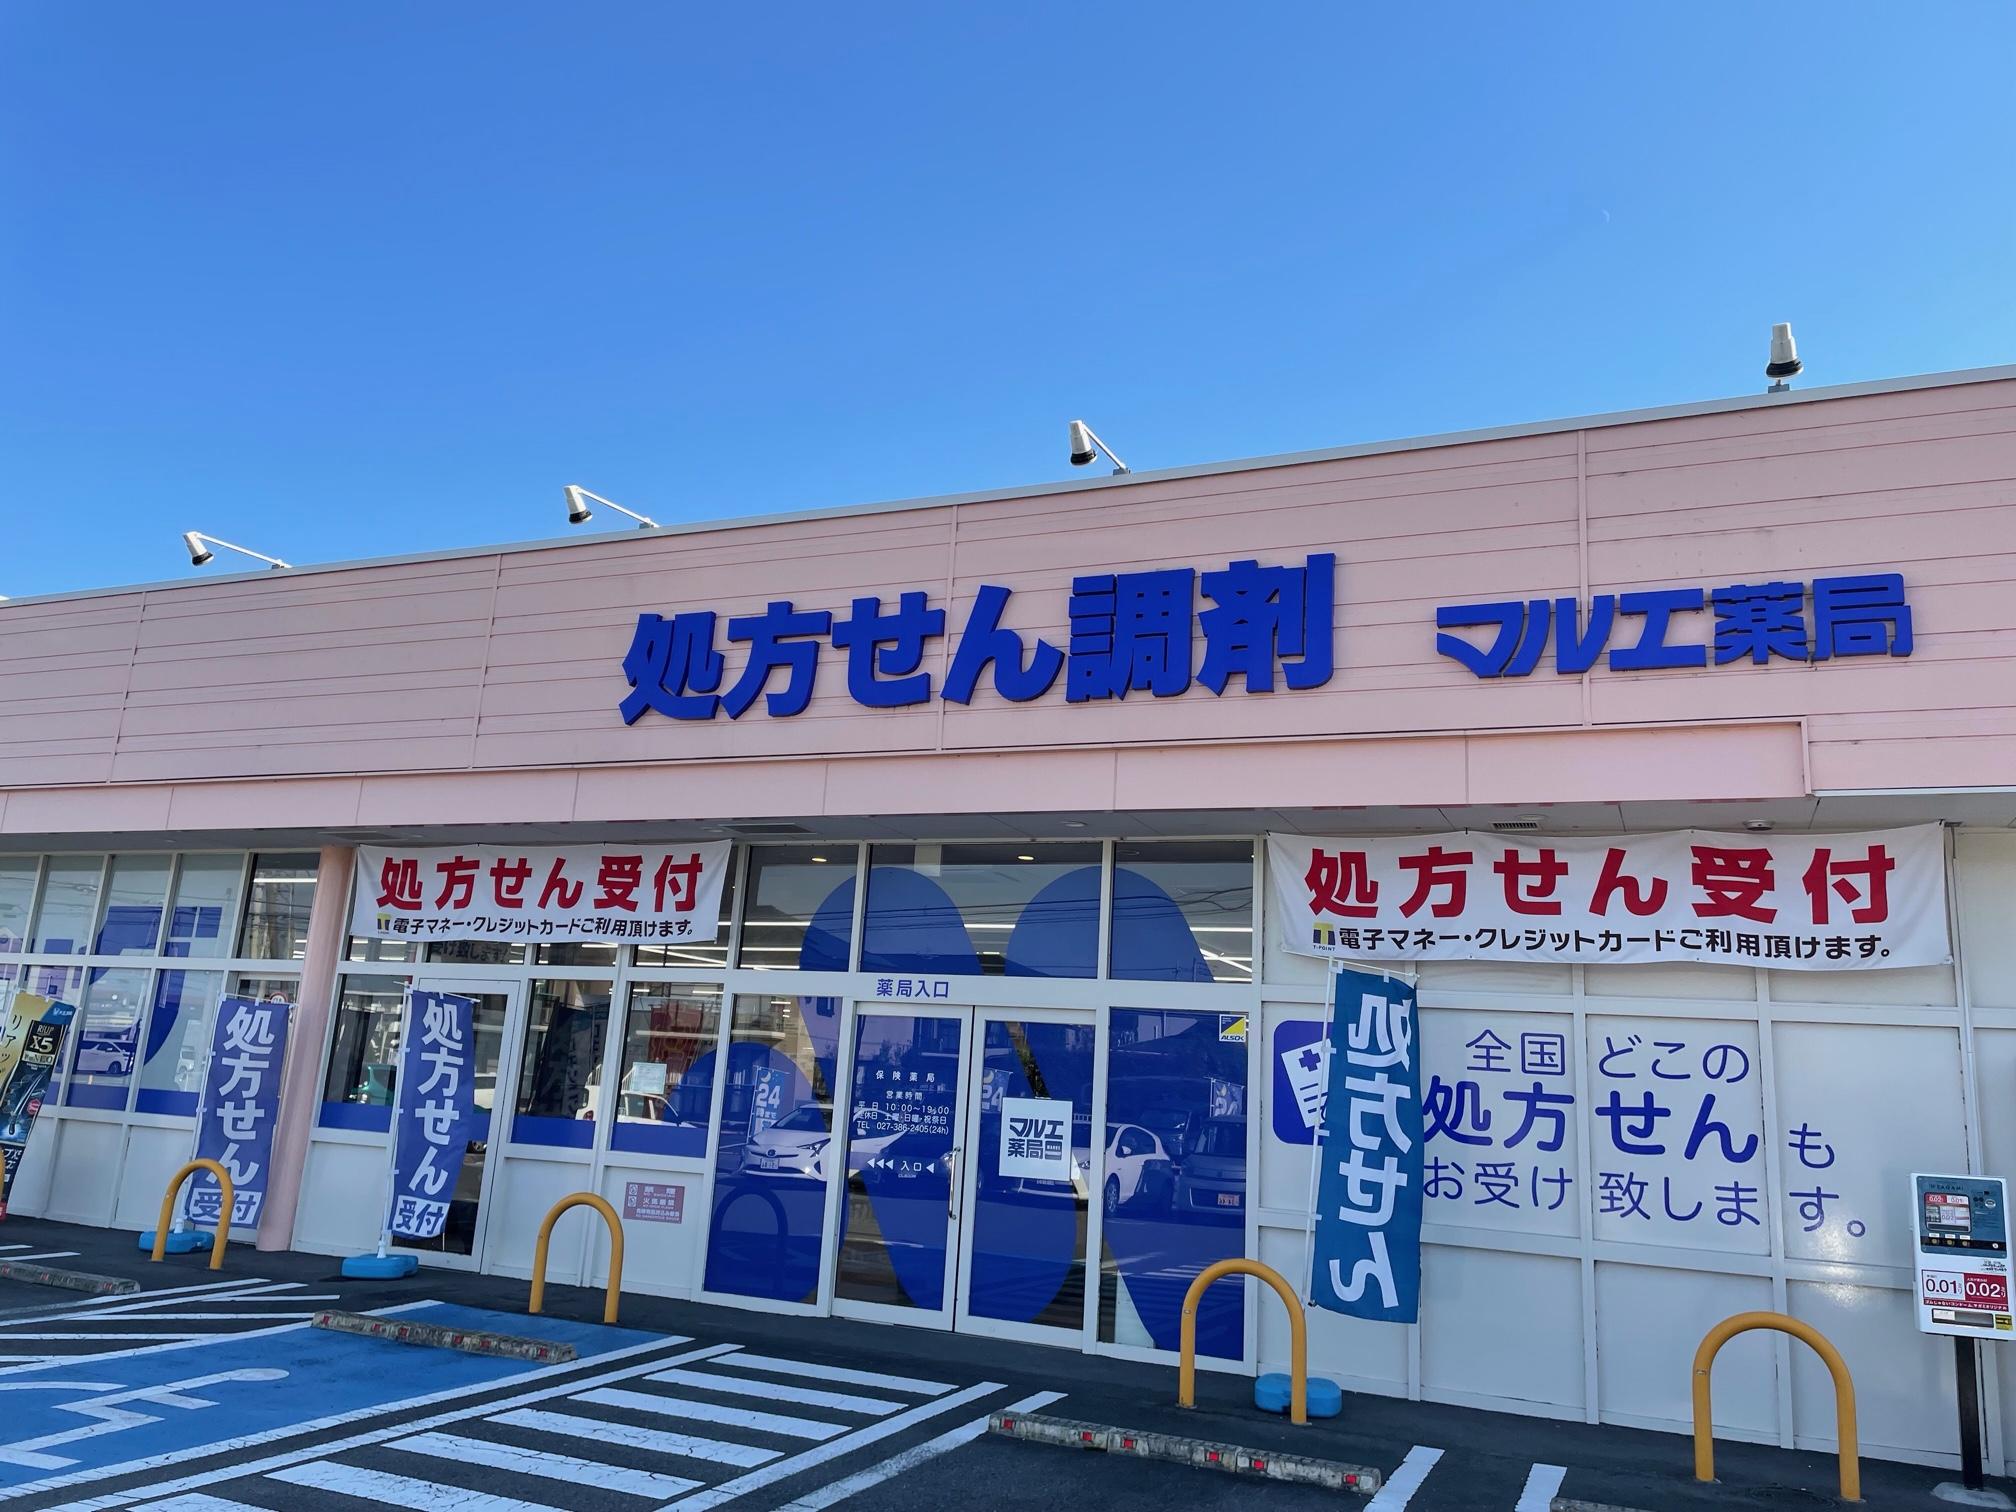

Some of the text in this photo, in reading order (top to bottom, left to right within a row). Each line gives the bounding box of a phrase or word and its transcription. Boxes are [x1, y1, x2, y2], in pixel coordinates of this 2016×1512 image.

[619, 553, 1914, 726] 処方せん調剤 マルエ薬局
[376, 852, 704, 913] 処方せん受付
[1304, 843, 1898, 926] 処方せん受付
[1338, 925, 1893, 961] 電子マネー・クレジットカードご利用頂けます。
[876, 977, 950, 999] 薬局入口
[29, 1035, 54, 1053] X5
[875, 1070, 935, 1083] 保険薬局
[208, 1005, 276, 1187] 処方せん
[409, 999, 463, 1196] 処方せん
[886, 1090, 923, 1101] 営業時間
[857, 1120, 870, 1129] TEL
[1009, 1117, 1064, 1141] マルエ
[1007, 1137, 1044, 1160] 薬局
[900, 1160, 922, 1172] 入口
[1424, 1156, 1867, 1239] お受け致します。
[394, 1201, 445, 1234] 受付
[1925, 1278, 1957, 1294] 0.01
[1965, 1281, 2001, 1298] 0.02
